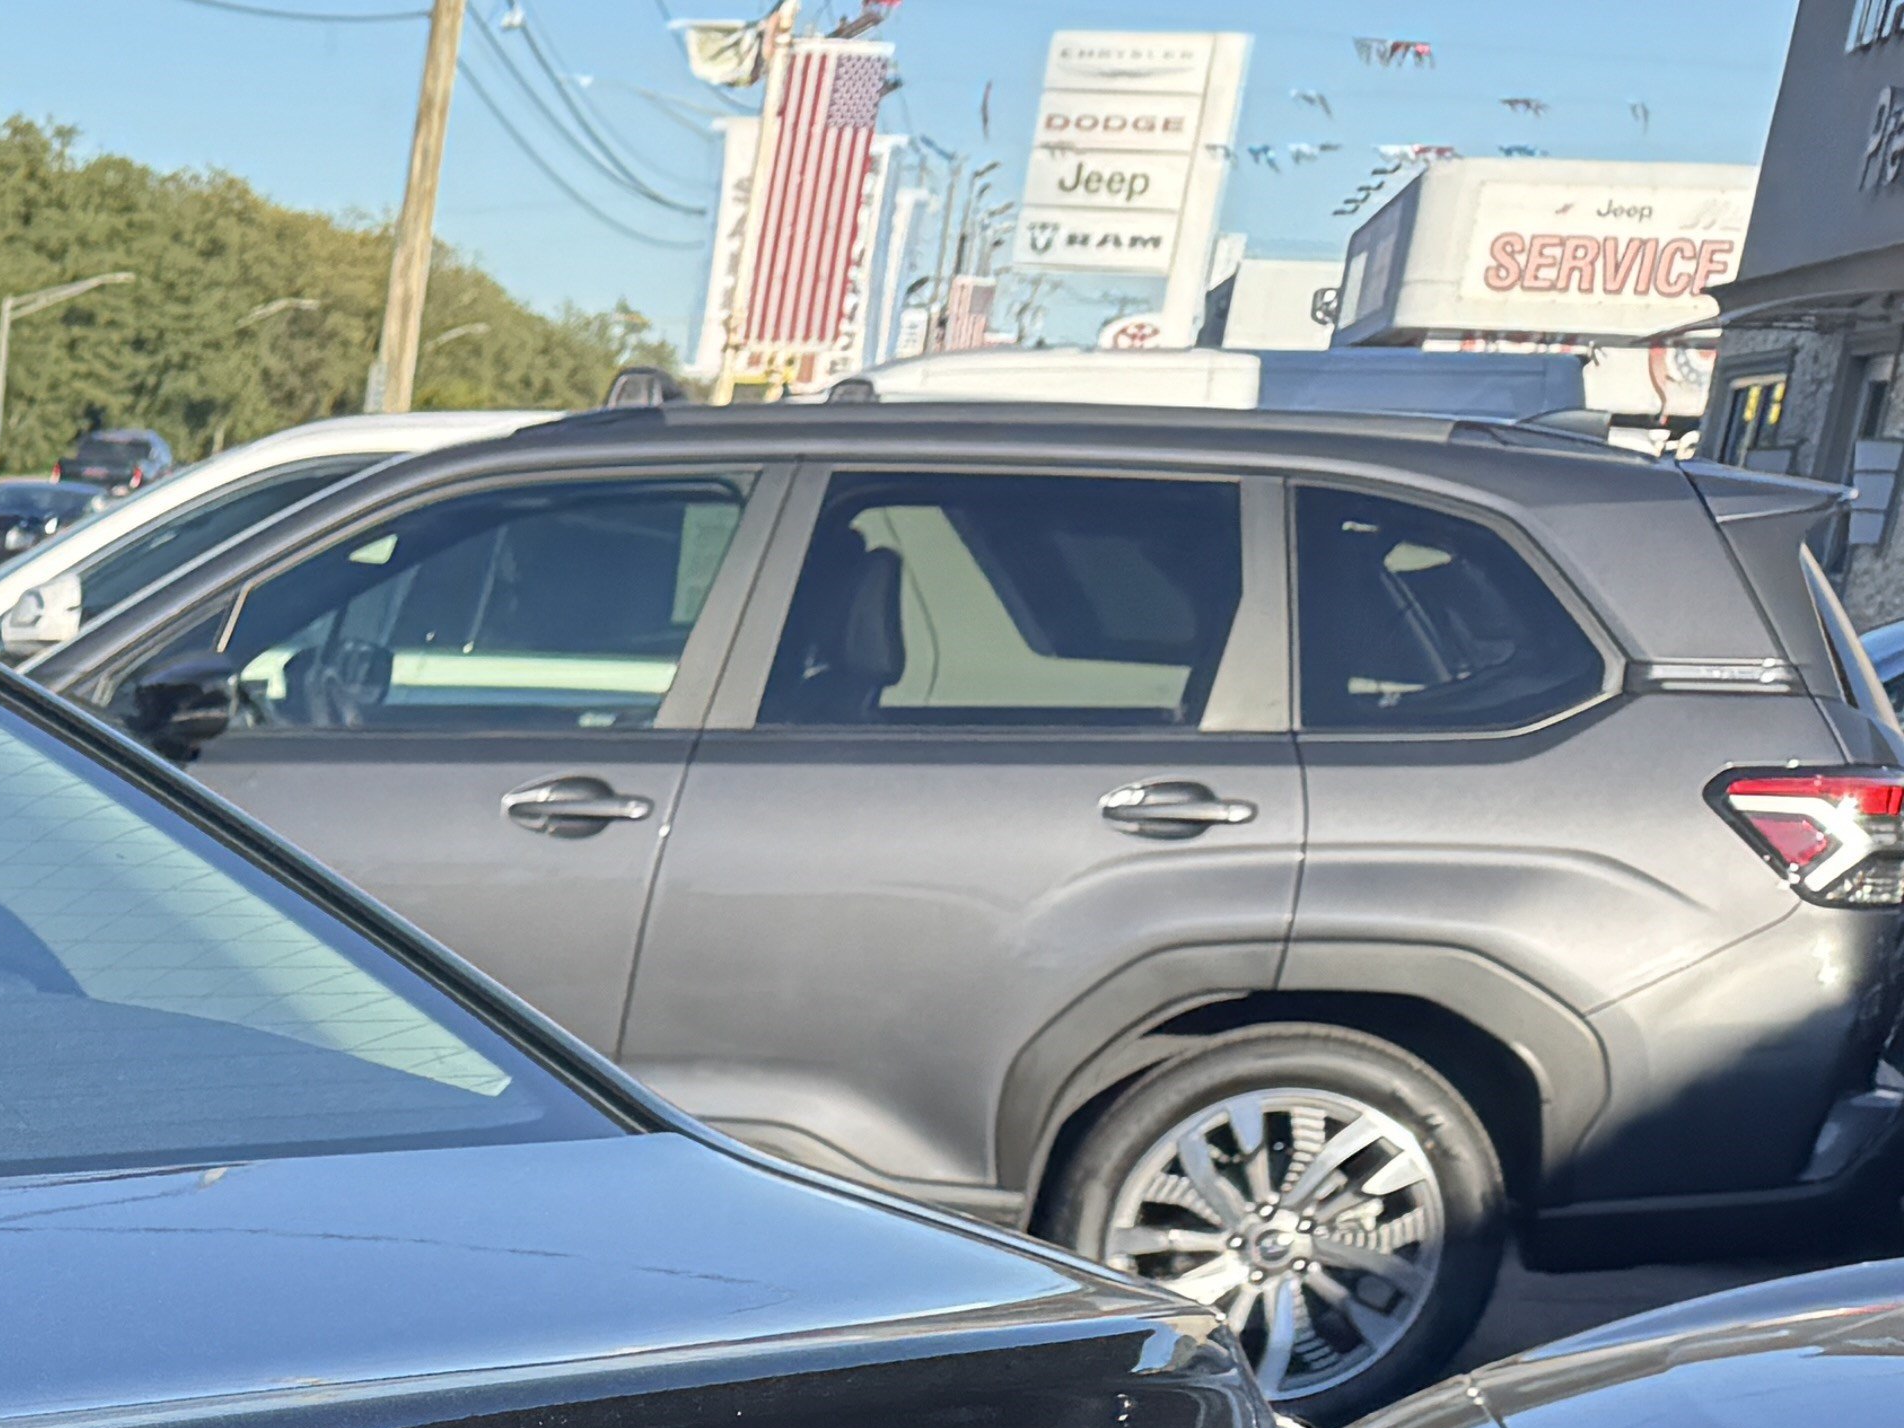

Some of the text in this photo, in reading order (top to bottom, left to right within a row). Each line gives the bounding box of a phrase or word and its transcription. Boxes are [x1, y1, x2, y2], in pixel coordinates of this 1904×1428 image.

[1044, 112, 1185, 133] DODGE
[1057, 161, 1151, 203] Jeep
[1596, 199, 1653, 223] Jeep
[1064, 231, 1163, 250] RAM
[1483, 230, 1735, 299] SERVICE
